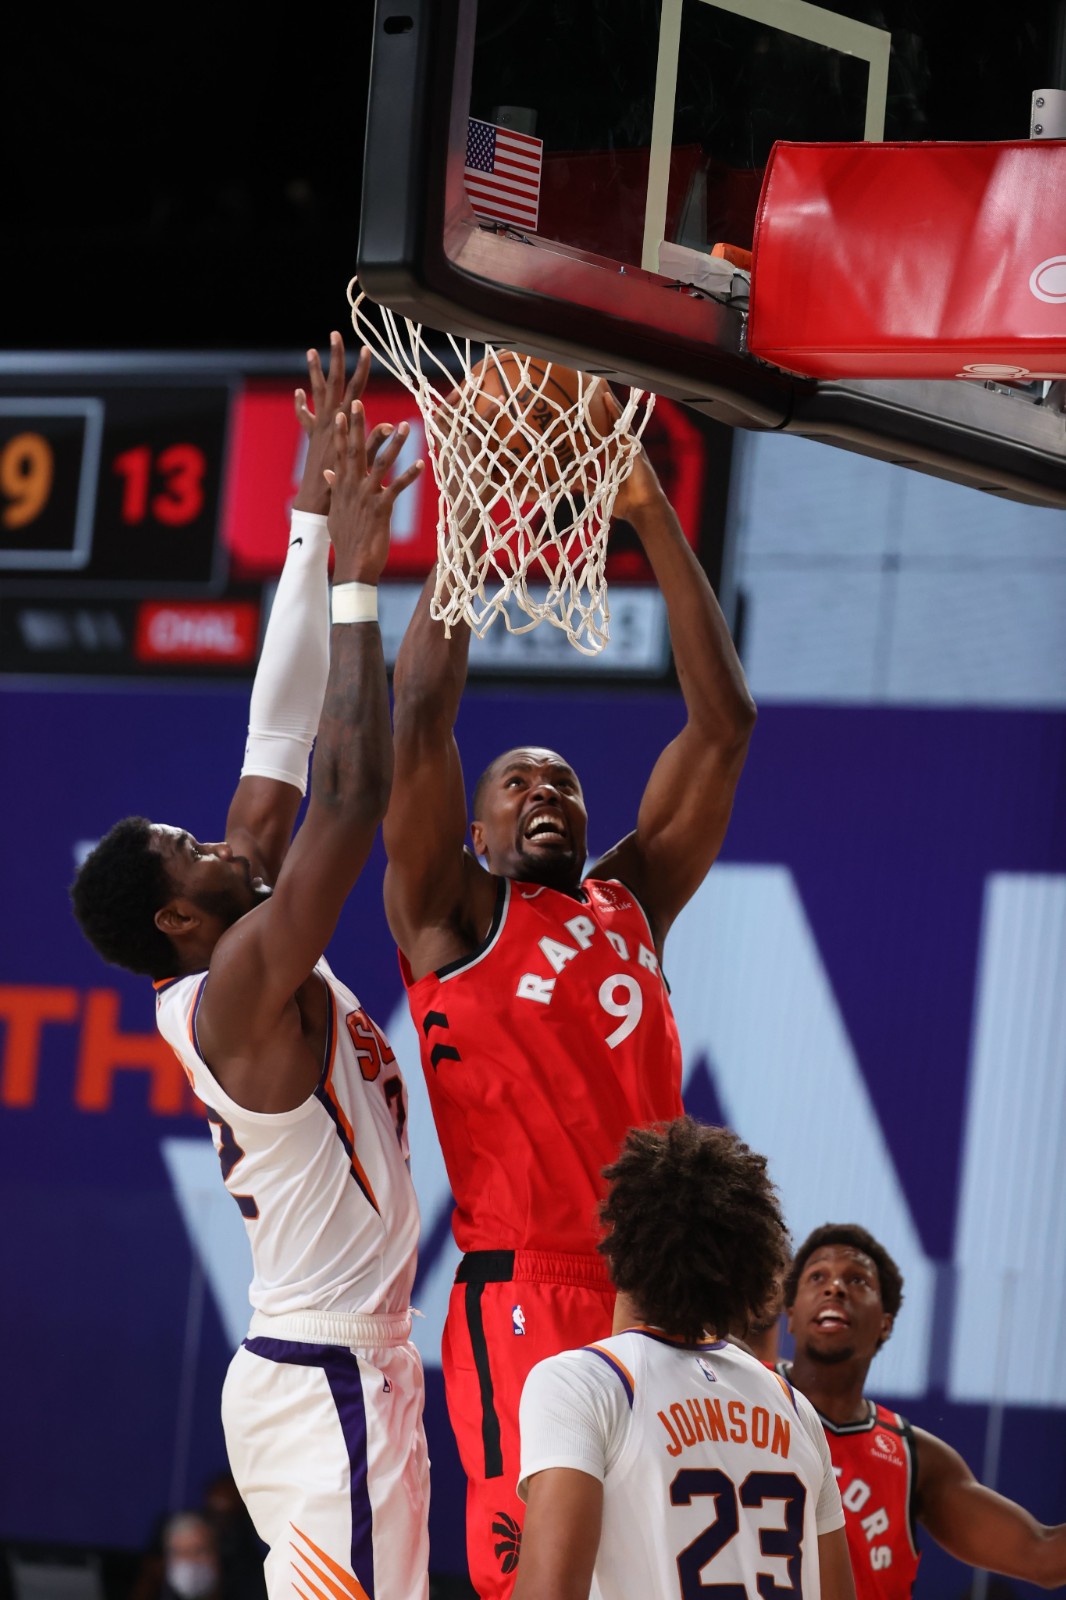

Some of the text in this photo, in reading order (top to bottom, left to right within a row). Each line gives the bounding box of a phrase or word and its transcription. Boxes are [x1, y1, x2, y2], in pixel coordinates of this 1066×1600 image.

[0, 432, 53, 529] 9
[114, 443, 206, 527] 13
[516, 914, 660, 1005] RAPOR
[0, 984, 207, 1118] TH
[598, 973, 643, 1050] 9
[657, 1397, 791, 1460] JOHNSON
[670, 1468, 806, 1600] 23
[832, 1464, 893, 1572] ORS
